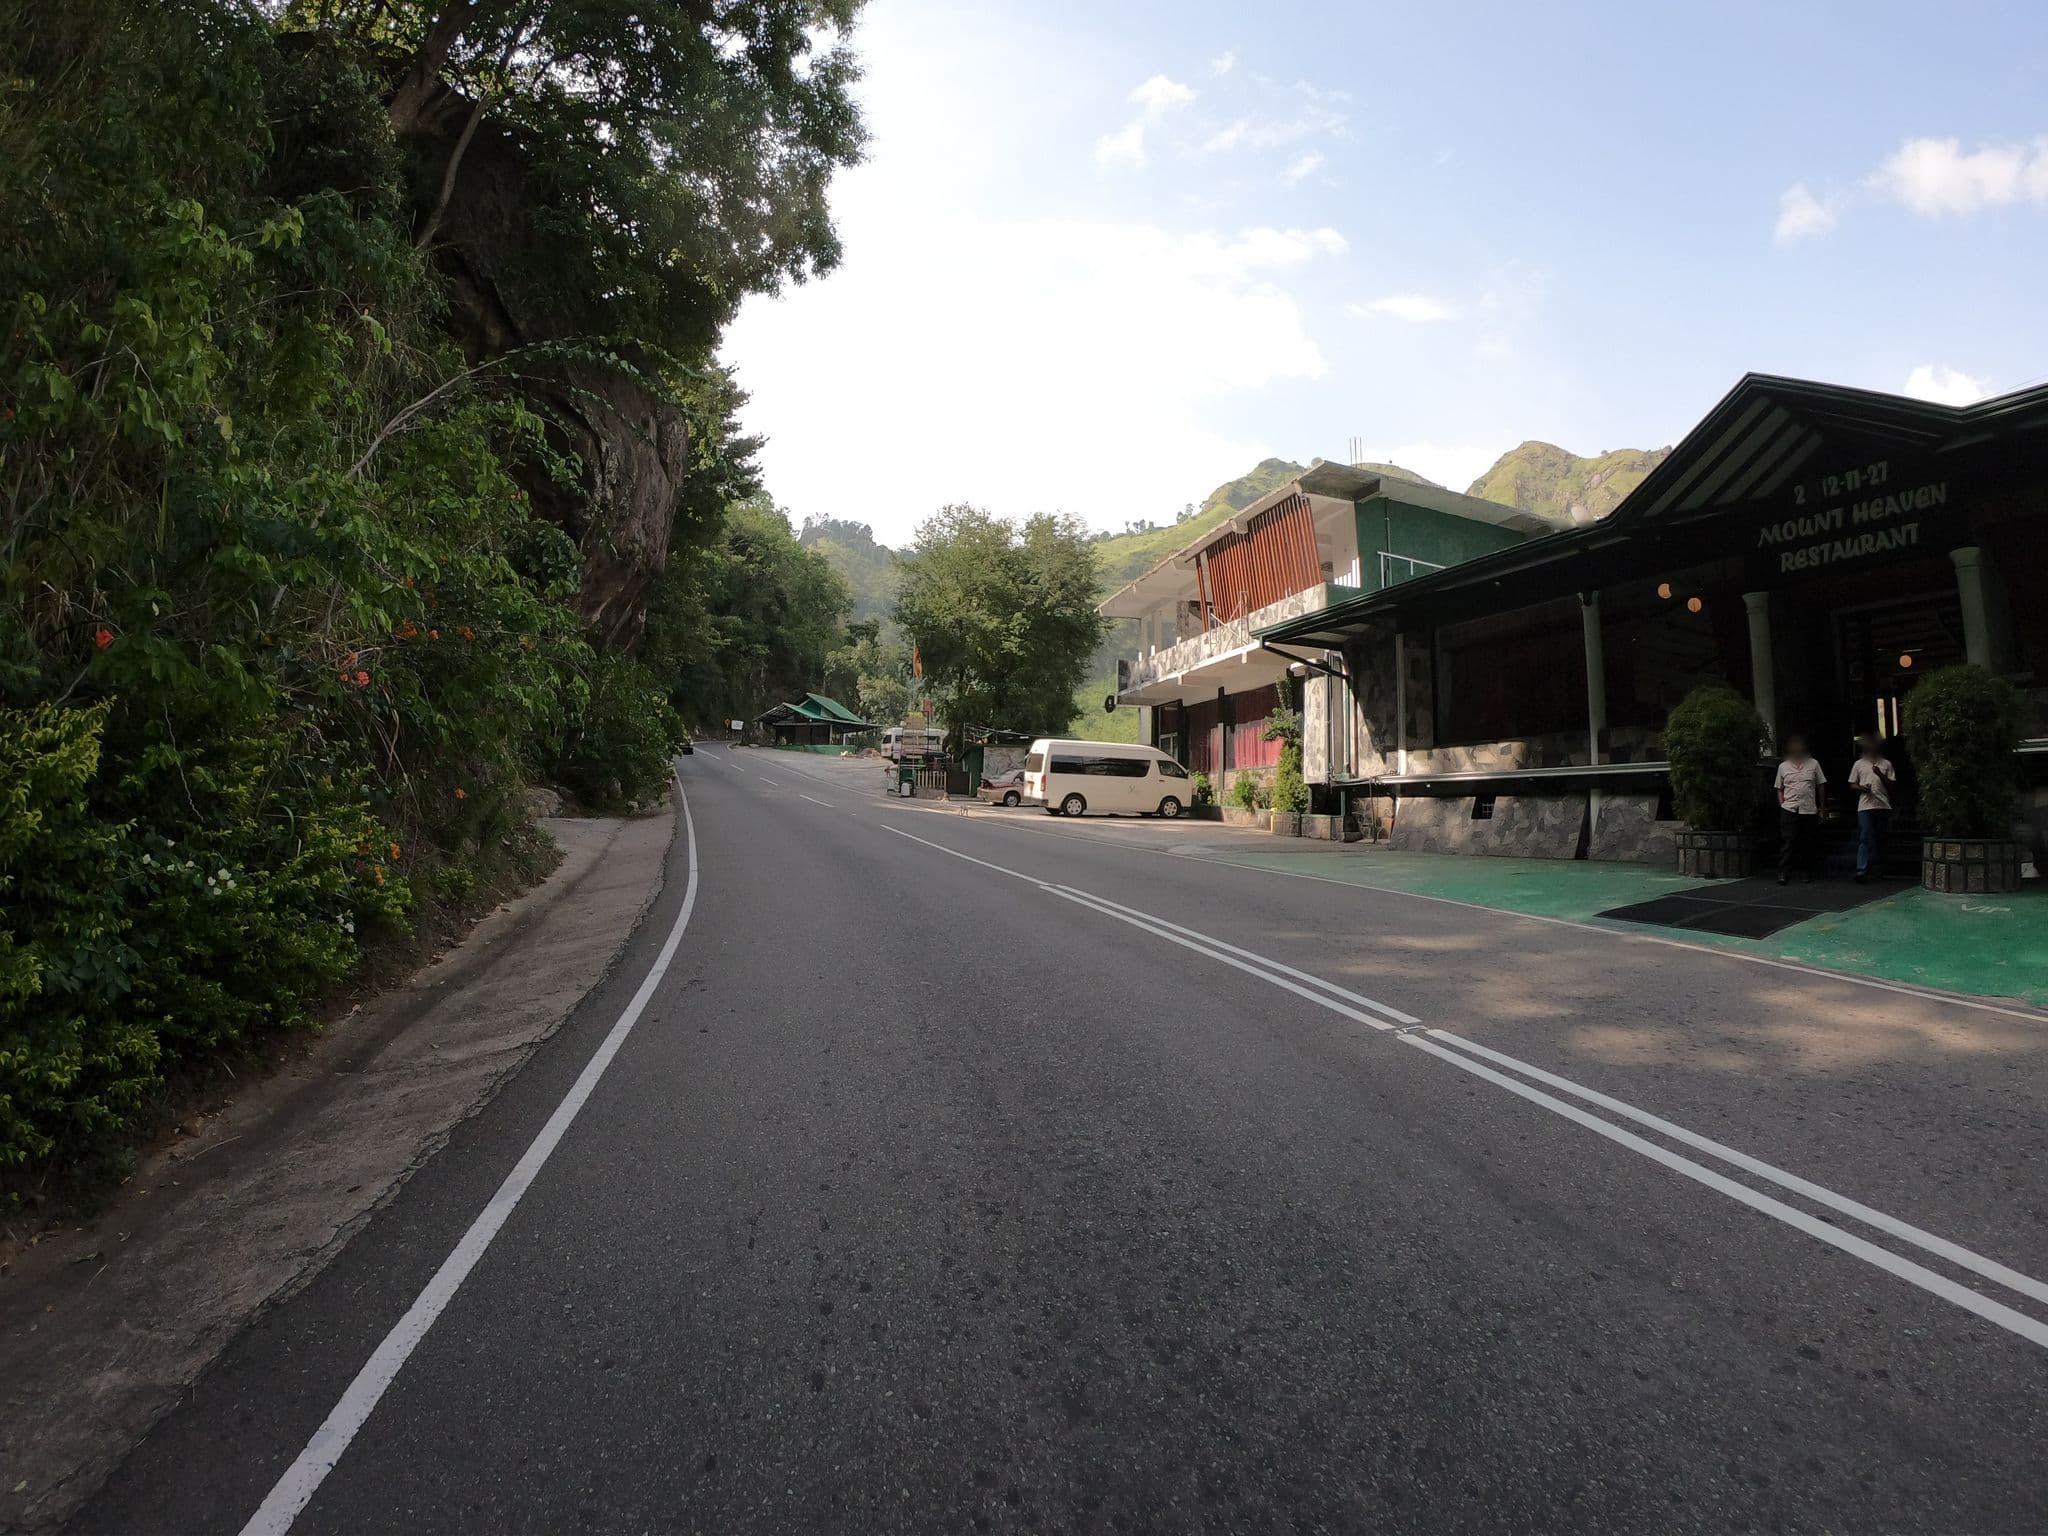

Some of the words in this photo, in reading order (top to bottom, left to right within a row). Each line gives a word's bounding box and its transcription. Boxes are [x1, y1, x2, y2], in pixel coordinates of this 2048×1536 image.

[1758, 508, 1845, 547] MOUNT
[1852, 482, 1947, 523] HEAVEN
[1780, 522, 1920, 573] RESTAURANT
